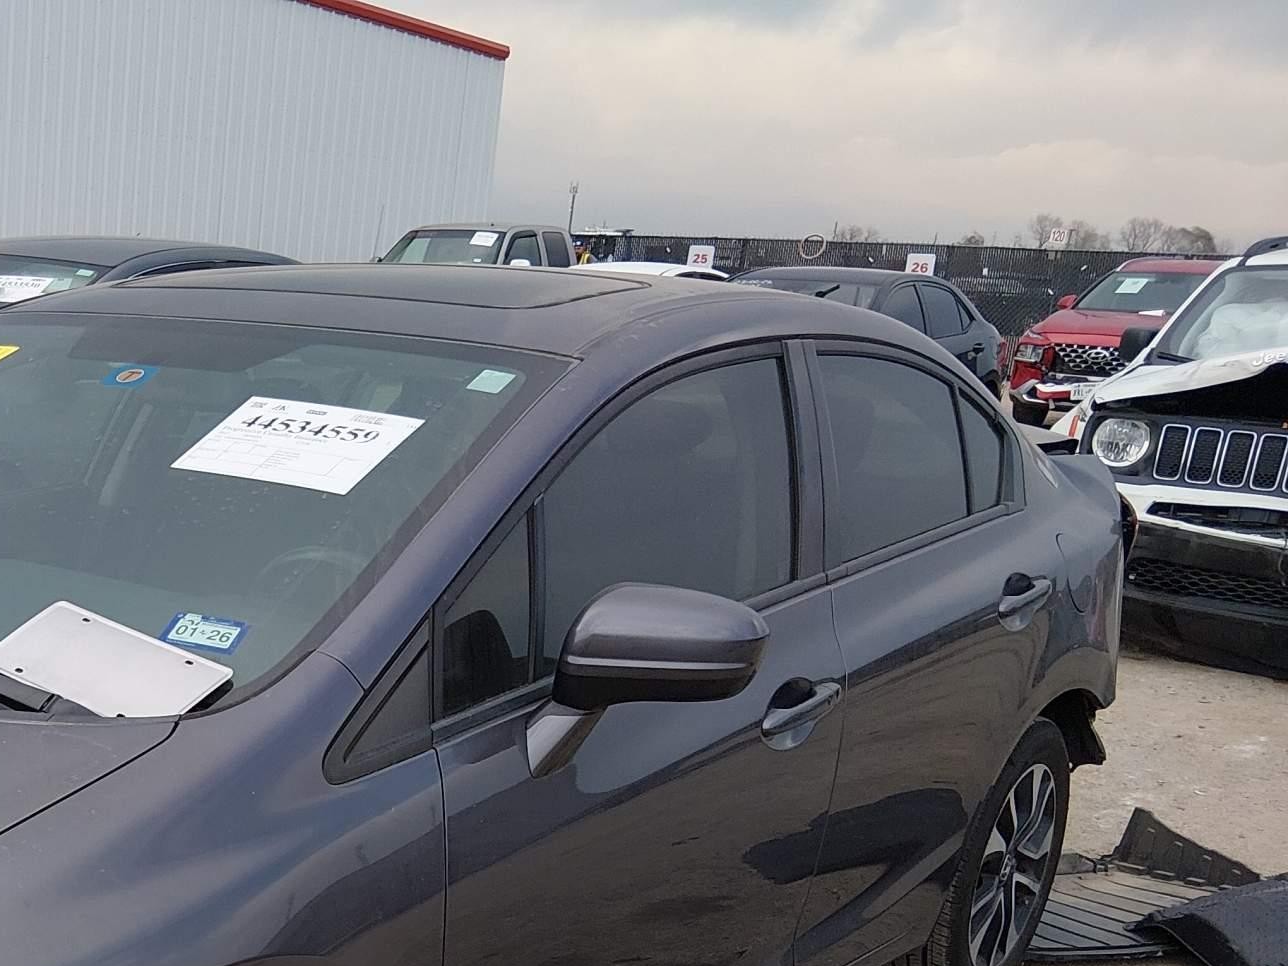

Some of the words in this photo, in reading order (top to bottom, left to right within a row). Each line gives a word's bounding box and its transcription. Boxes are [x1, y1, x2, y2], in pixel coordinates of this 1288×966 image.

[1052, 230, 1066, 242] 120
[692, 253, 709, 264] 25
[910, 262, 929, 273] 26
[1252, 352, 1288, 367] Jee
[240, 414, 381, 443] 44534559
[175, 624, 199, 637] 01
[206, 629, 233, 643] 26
